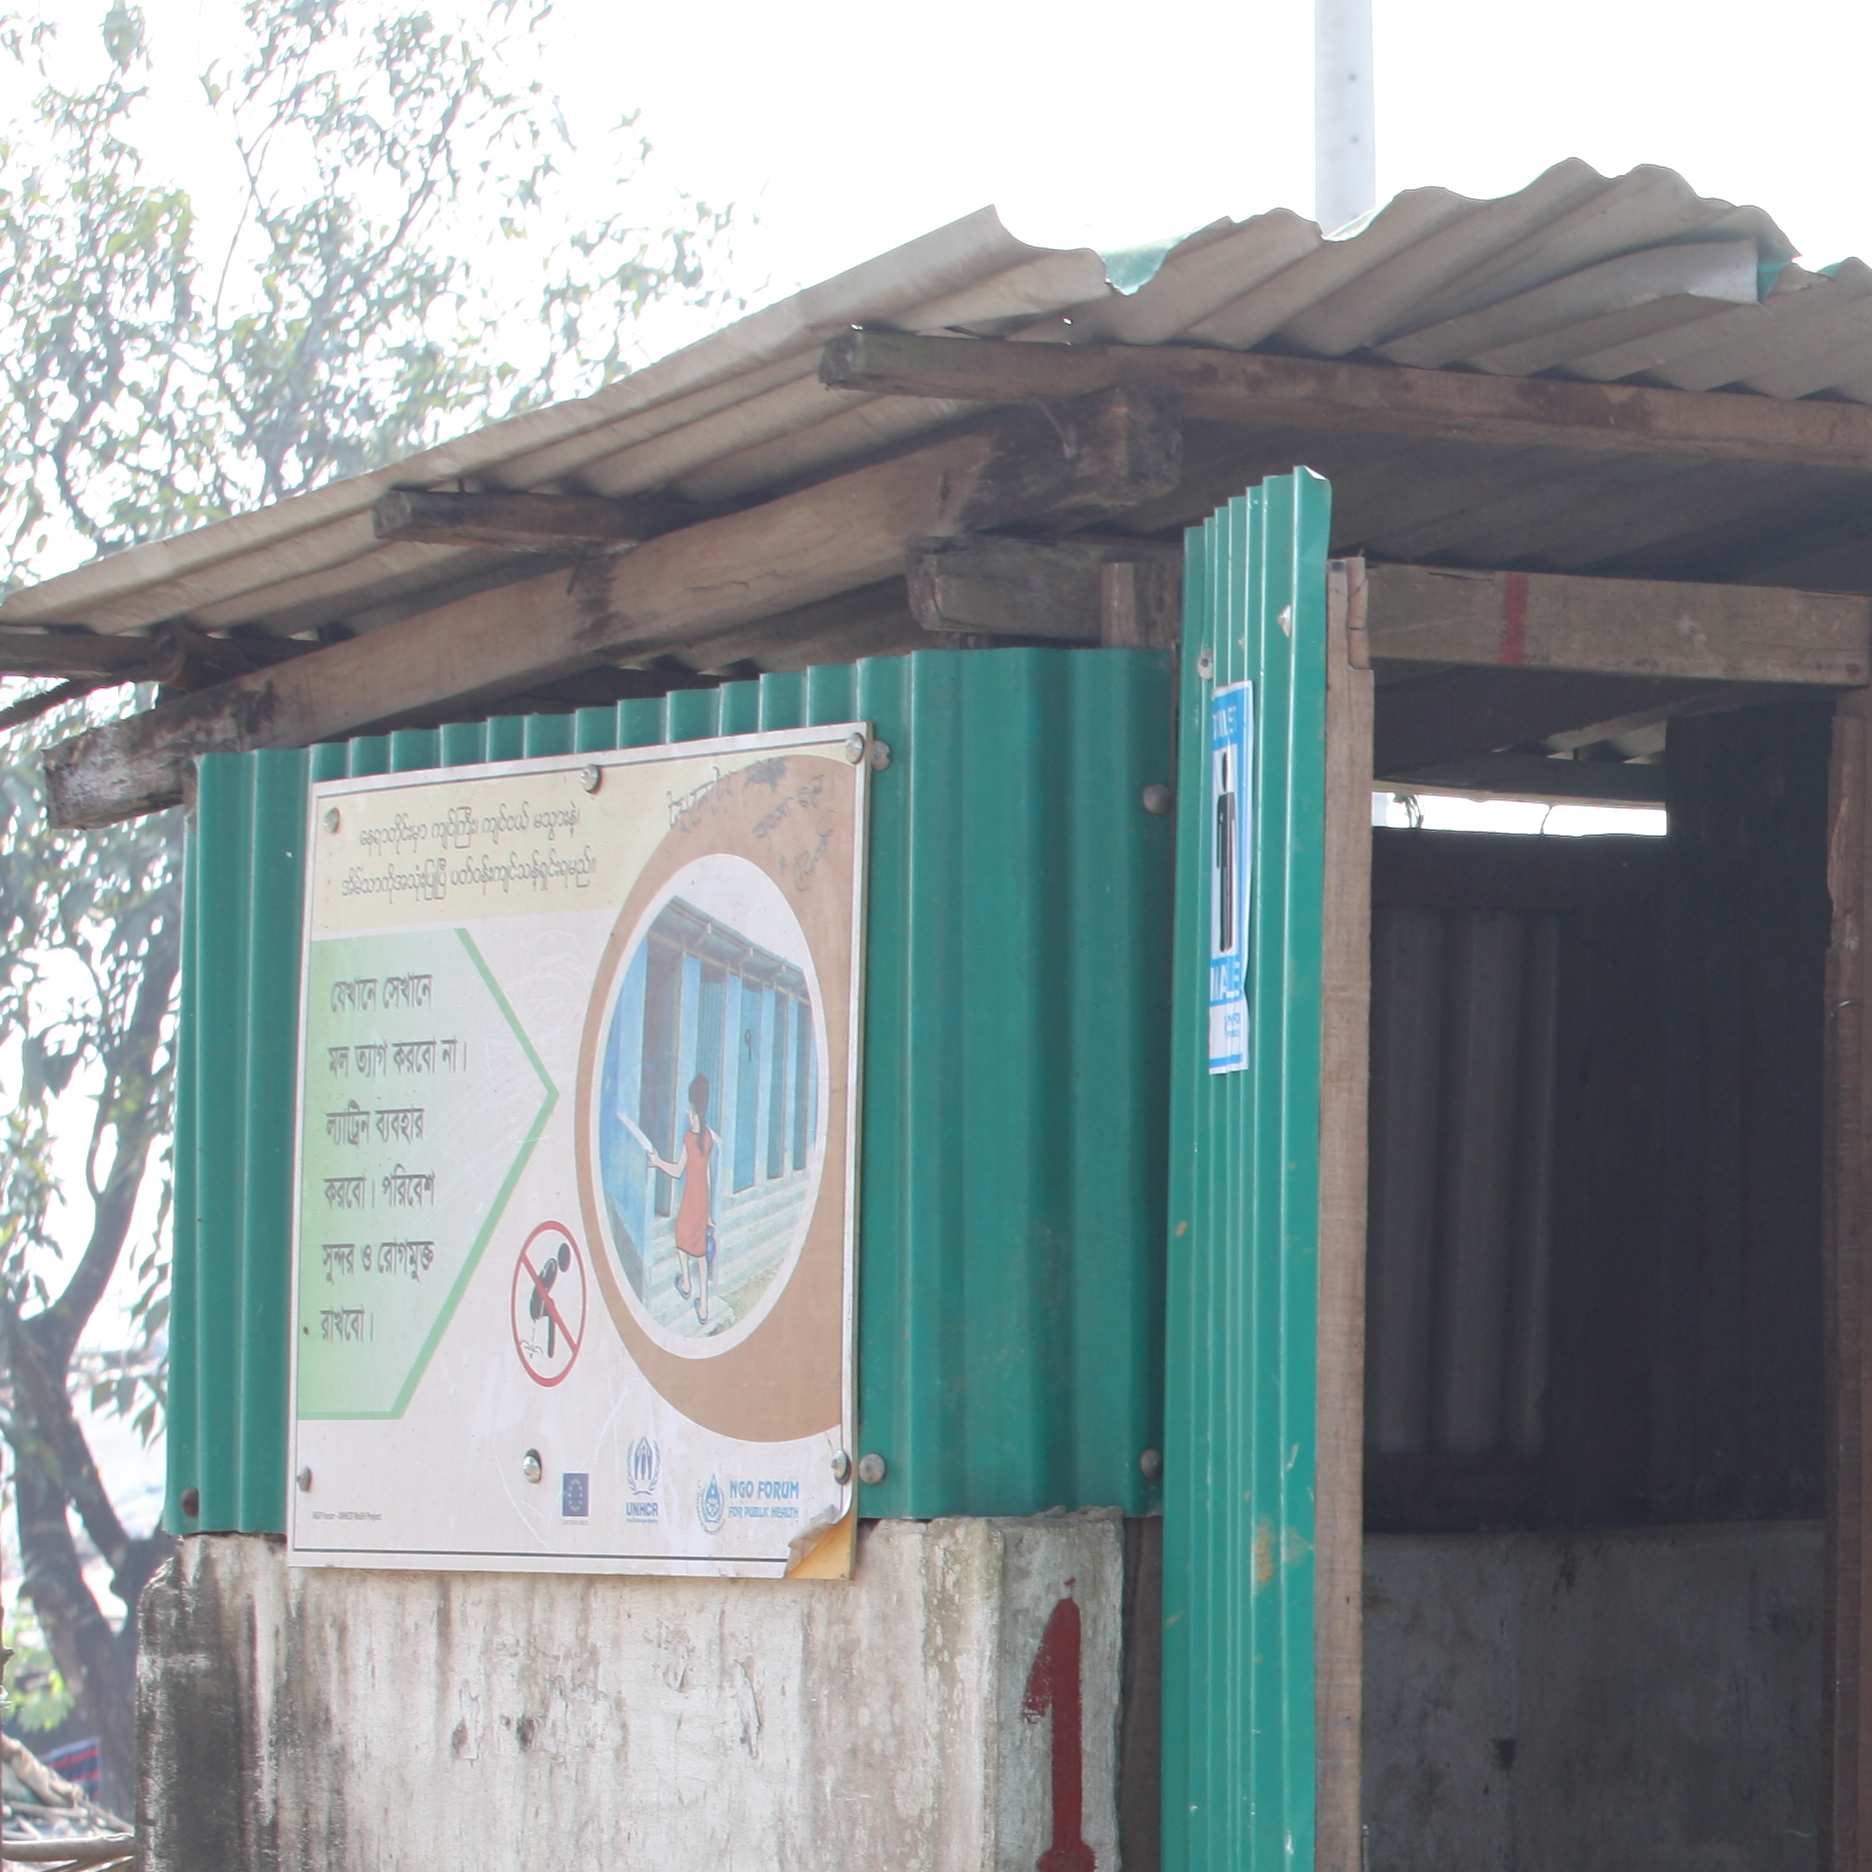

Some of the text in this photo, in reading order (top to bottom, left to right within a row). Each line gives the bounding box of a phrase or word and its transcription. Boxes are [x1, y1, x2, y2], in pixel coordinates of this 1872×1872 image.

[331, 972, 433, 1013] যেখানে সেখানে
[328, 1046, 350, 1078] মল
[354, 1040, 388, 1077] ত্যাগ
[391, 1036, 437, 1074] করবো
[325, 1100, 425, 1146] ল্যাট্রিন ব্যবহার
[382, 1163, 436, 1208] পরিবেশ
[321, 1237, 434, 1285] সুন্দর ও রোগমুক্ত
[625, 1502, 659, 1517] UNHCR
[729, 1480, 799, 1500] NGO FORUM
